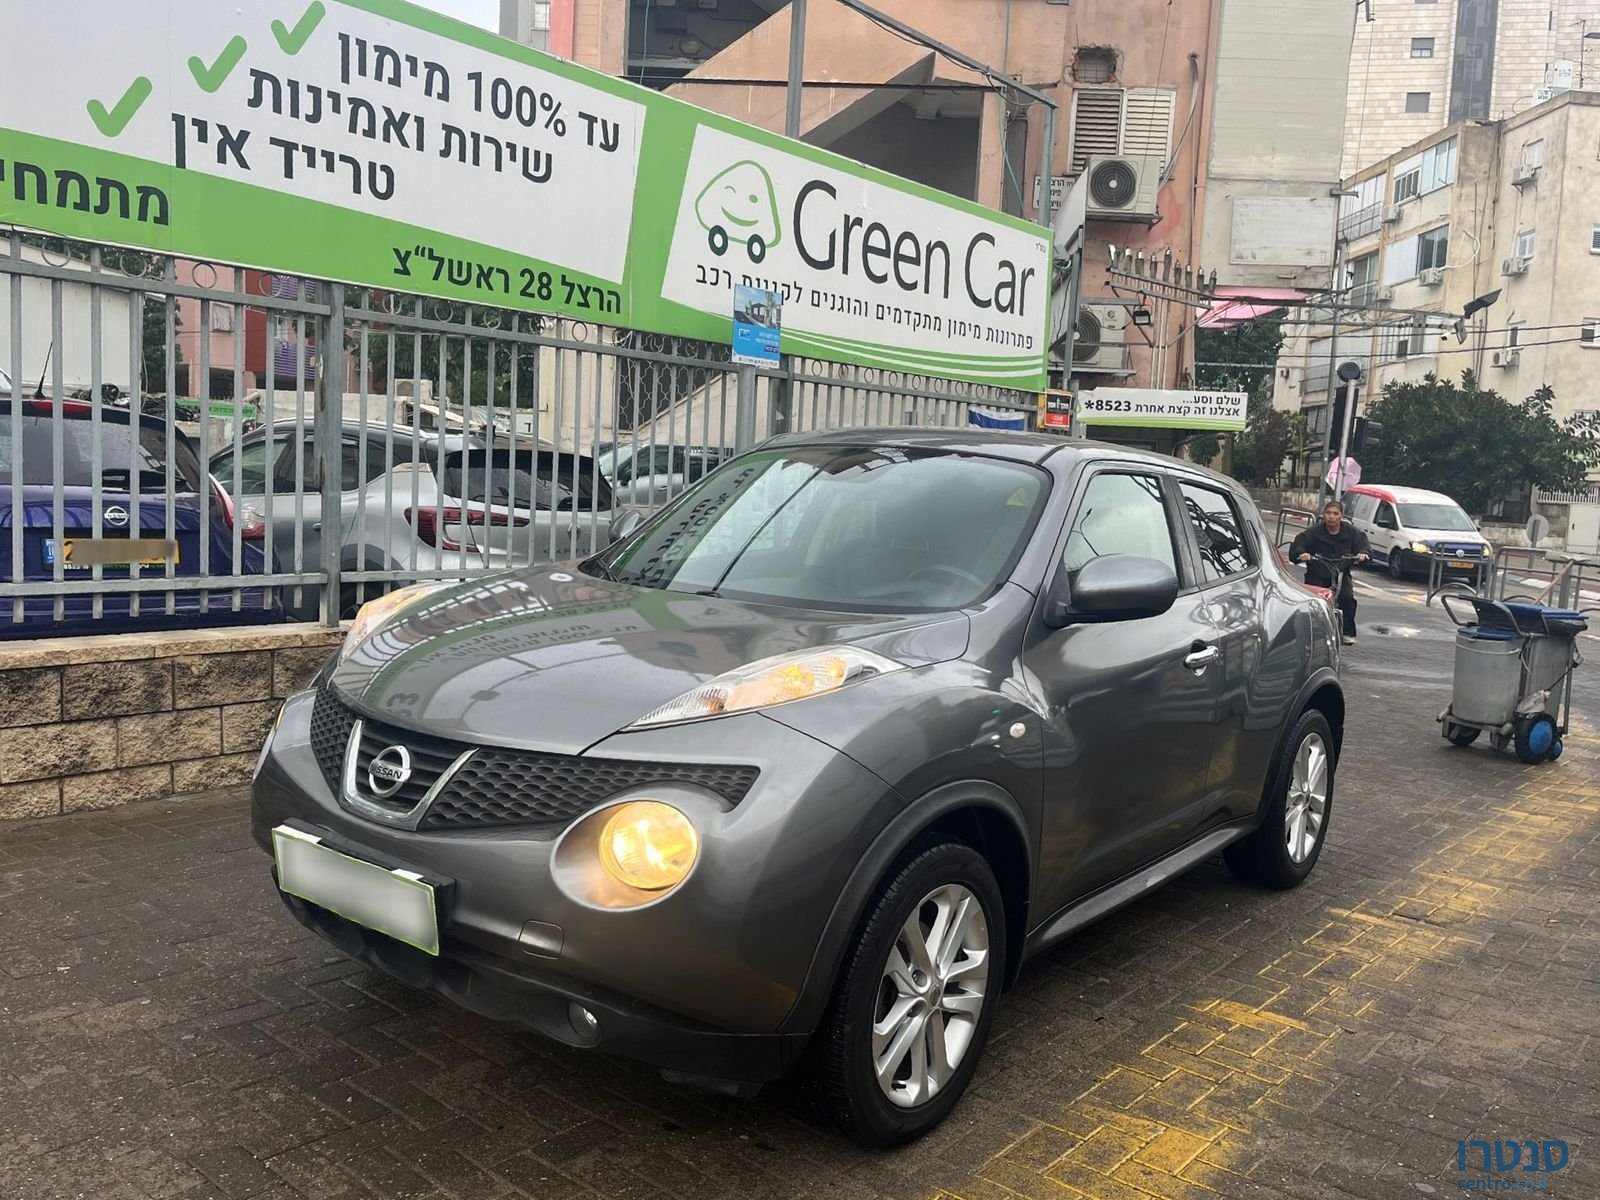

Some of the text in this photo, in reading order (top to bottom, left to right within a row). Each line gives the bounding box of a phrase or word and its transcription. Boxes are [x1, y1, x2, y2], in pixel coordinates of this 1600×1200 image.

[338, 32, 619, 153] עד 100% מימון
[247, 67, 552, 184] שירות ואמינות
[171, 112, 395, 201] טרייד אין
[793, 180, 1035, 317] Green Car
[519, 267, 552, 300] 28
[696, 264, 732, 289] רכב
[561, 274, 621, 314] הרצל
[811, 290, 868, 317] והוגנים
[876, 304, 942, 332] מתקדמים
[947, 318, 981, 339] מימון
[986, 327, 1033, 350] פתרונות
[1134, 404, 1164, 413] אחרת
[1168, 405, 1191, 416] קצת
[1194, 406, 1207, 415] זה
[1210, 405, 1240, 416] אצלנו
[1216, 394, 1240, 405] שלם
